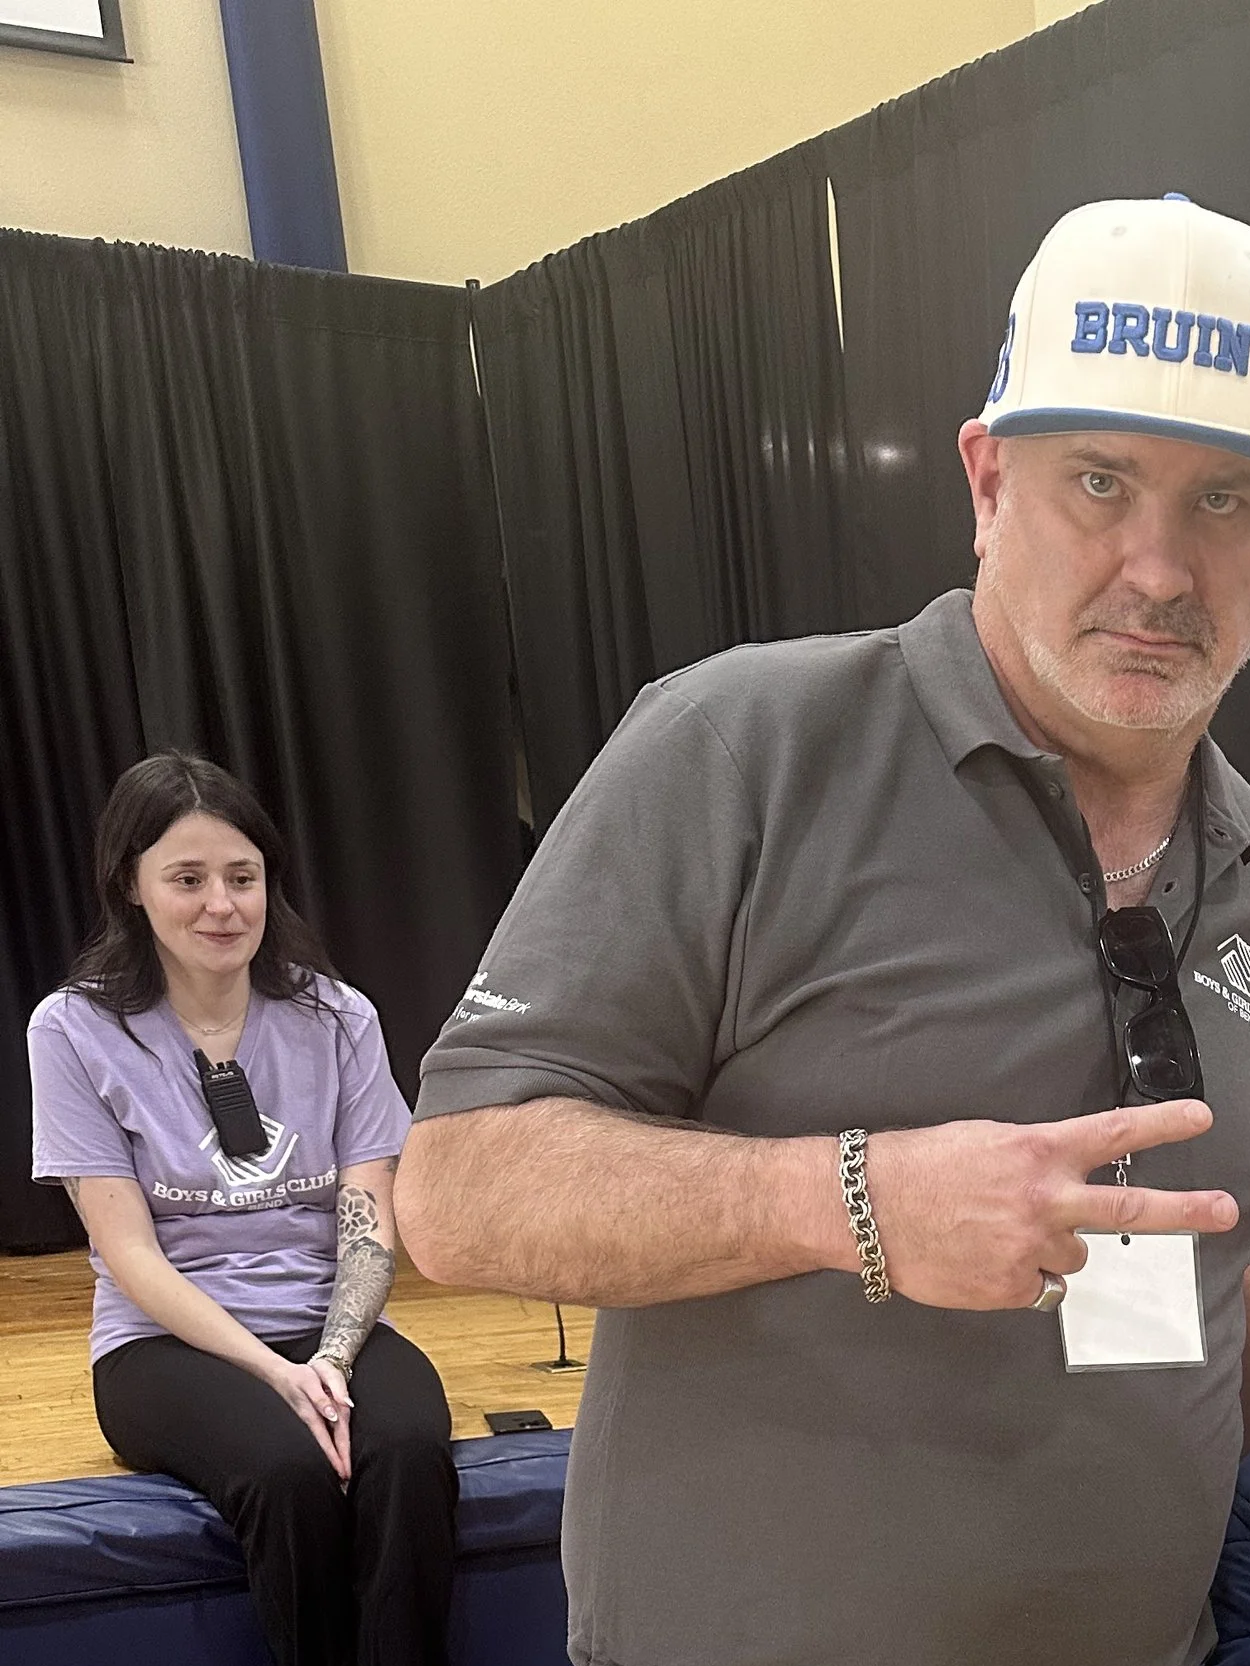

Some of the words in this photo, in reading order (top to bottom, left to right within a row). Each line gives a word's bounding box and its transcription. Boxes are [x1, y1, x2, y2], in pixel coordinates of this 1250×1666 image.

[1193, 970, 1221, 994] BOYS
[1222, 986, 1231, 1001] &
[1227, 1001, 1240, 1014] OF
[152, 1181, 208, 1201] BOYS
[211, 1189, 228, 1207] &
[230, 1183, 287, 1207] GIRLS
